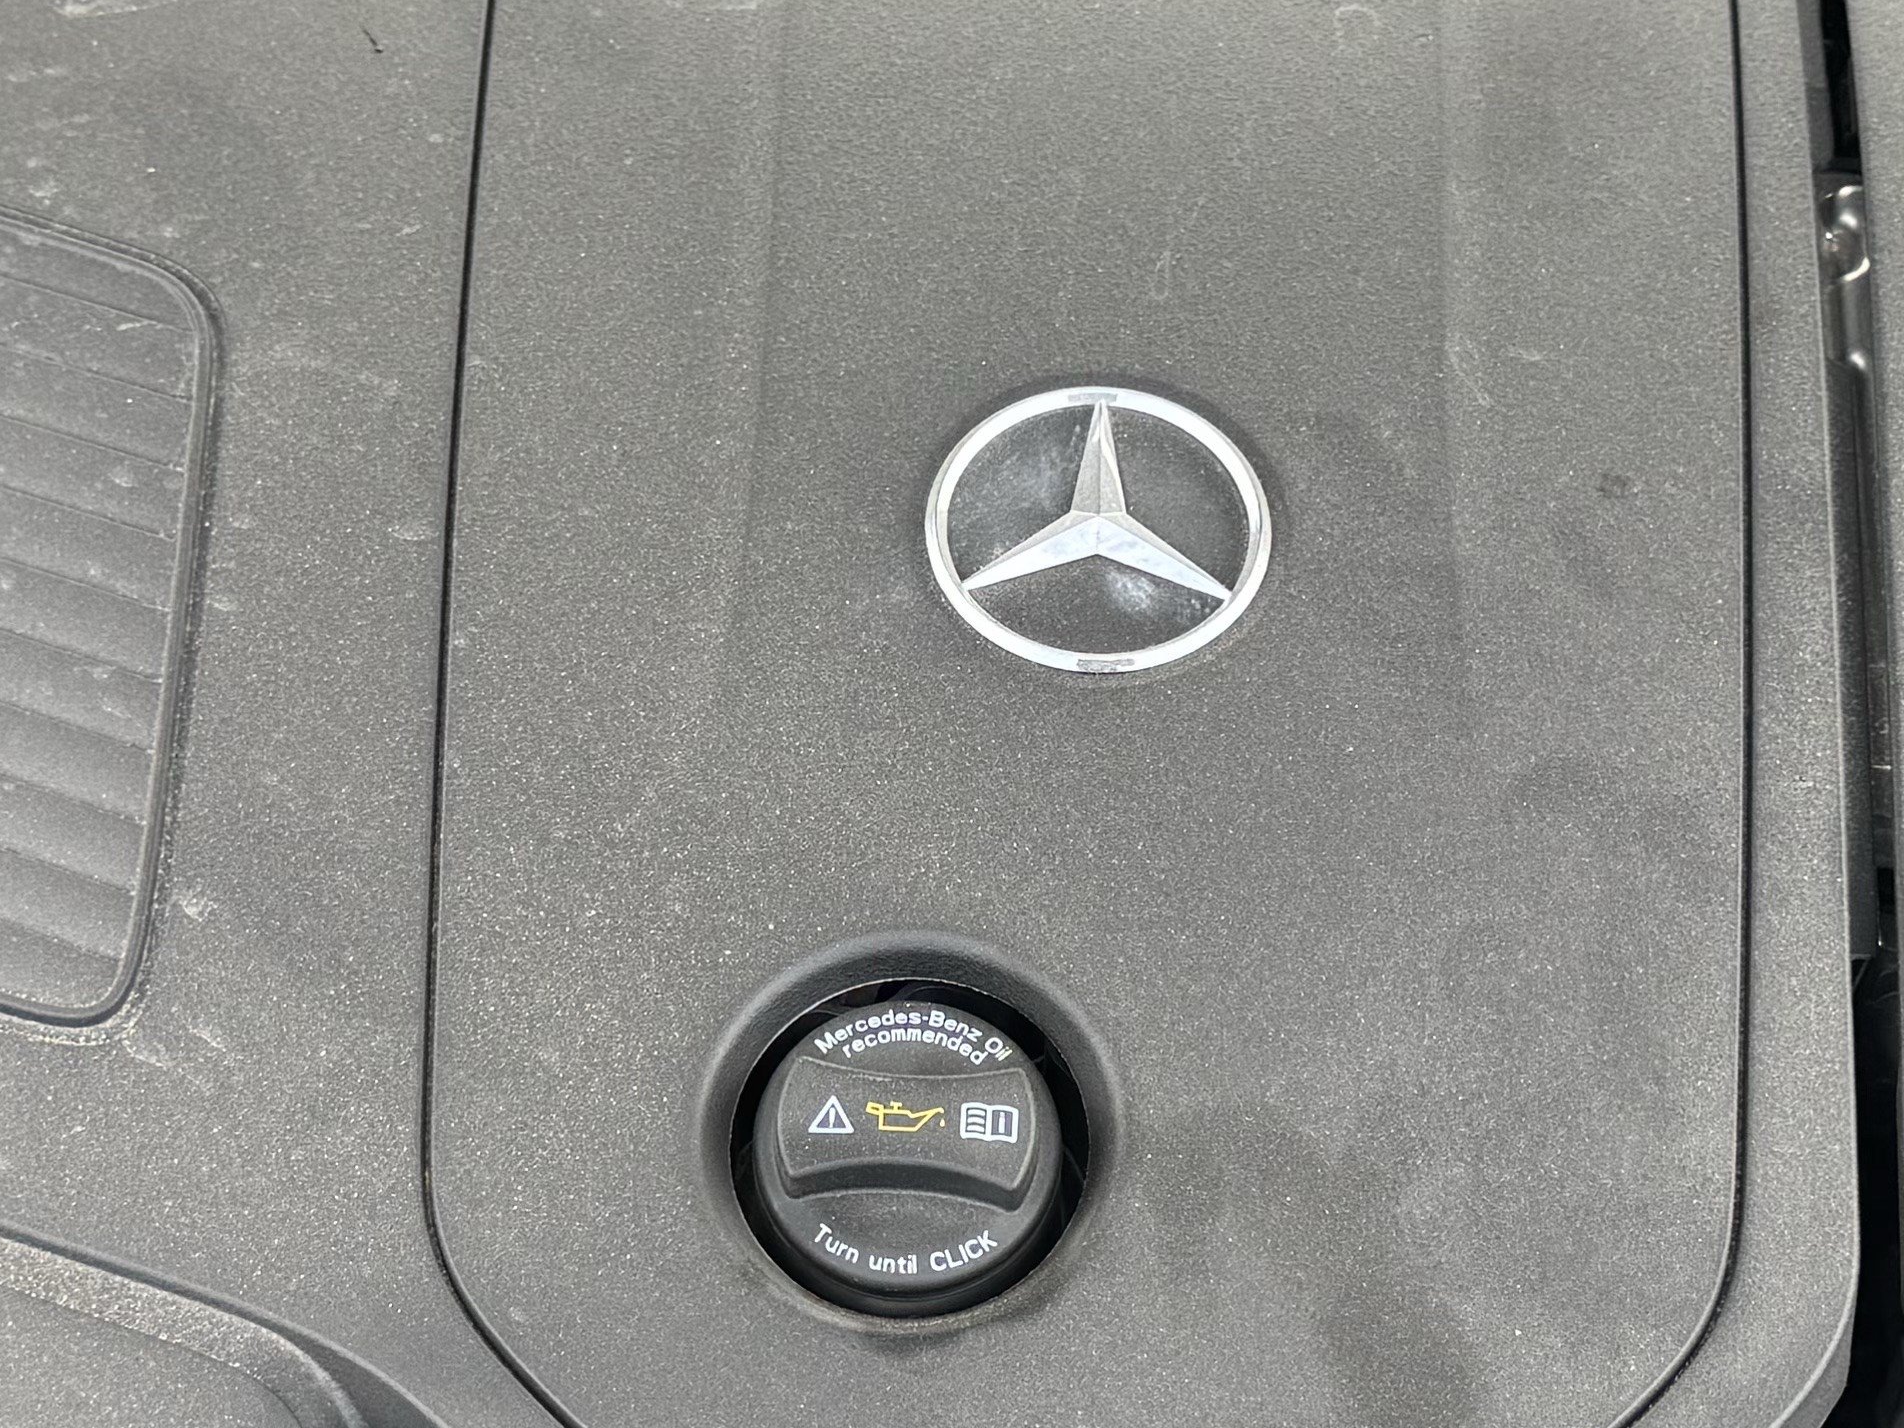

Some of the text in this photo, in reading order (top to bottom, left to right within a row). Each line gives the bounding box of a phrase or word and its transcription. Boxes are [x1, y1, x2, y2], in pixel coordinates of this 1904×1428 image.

[813, 1009, 1013, 1063] Mercedes-Benz Oil
[841, 1028, 989, 1066] recommended
[812, 1223, 998, 1275] Turn until CLICK
